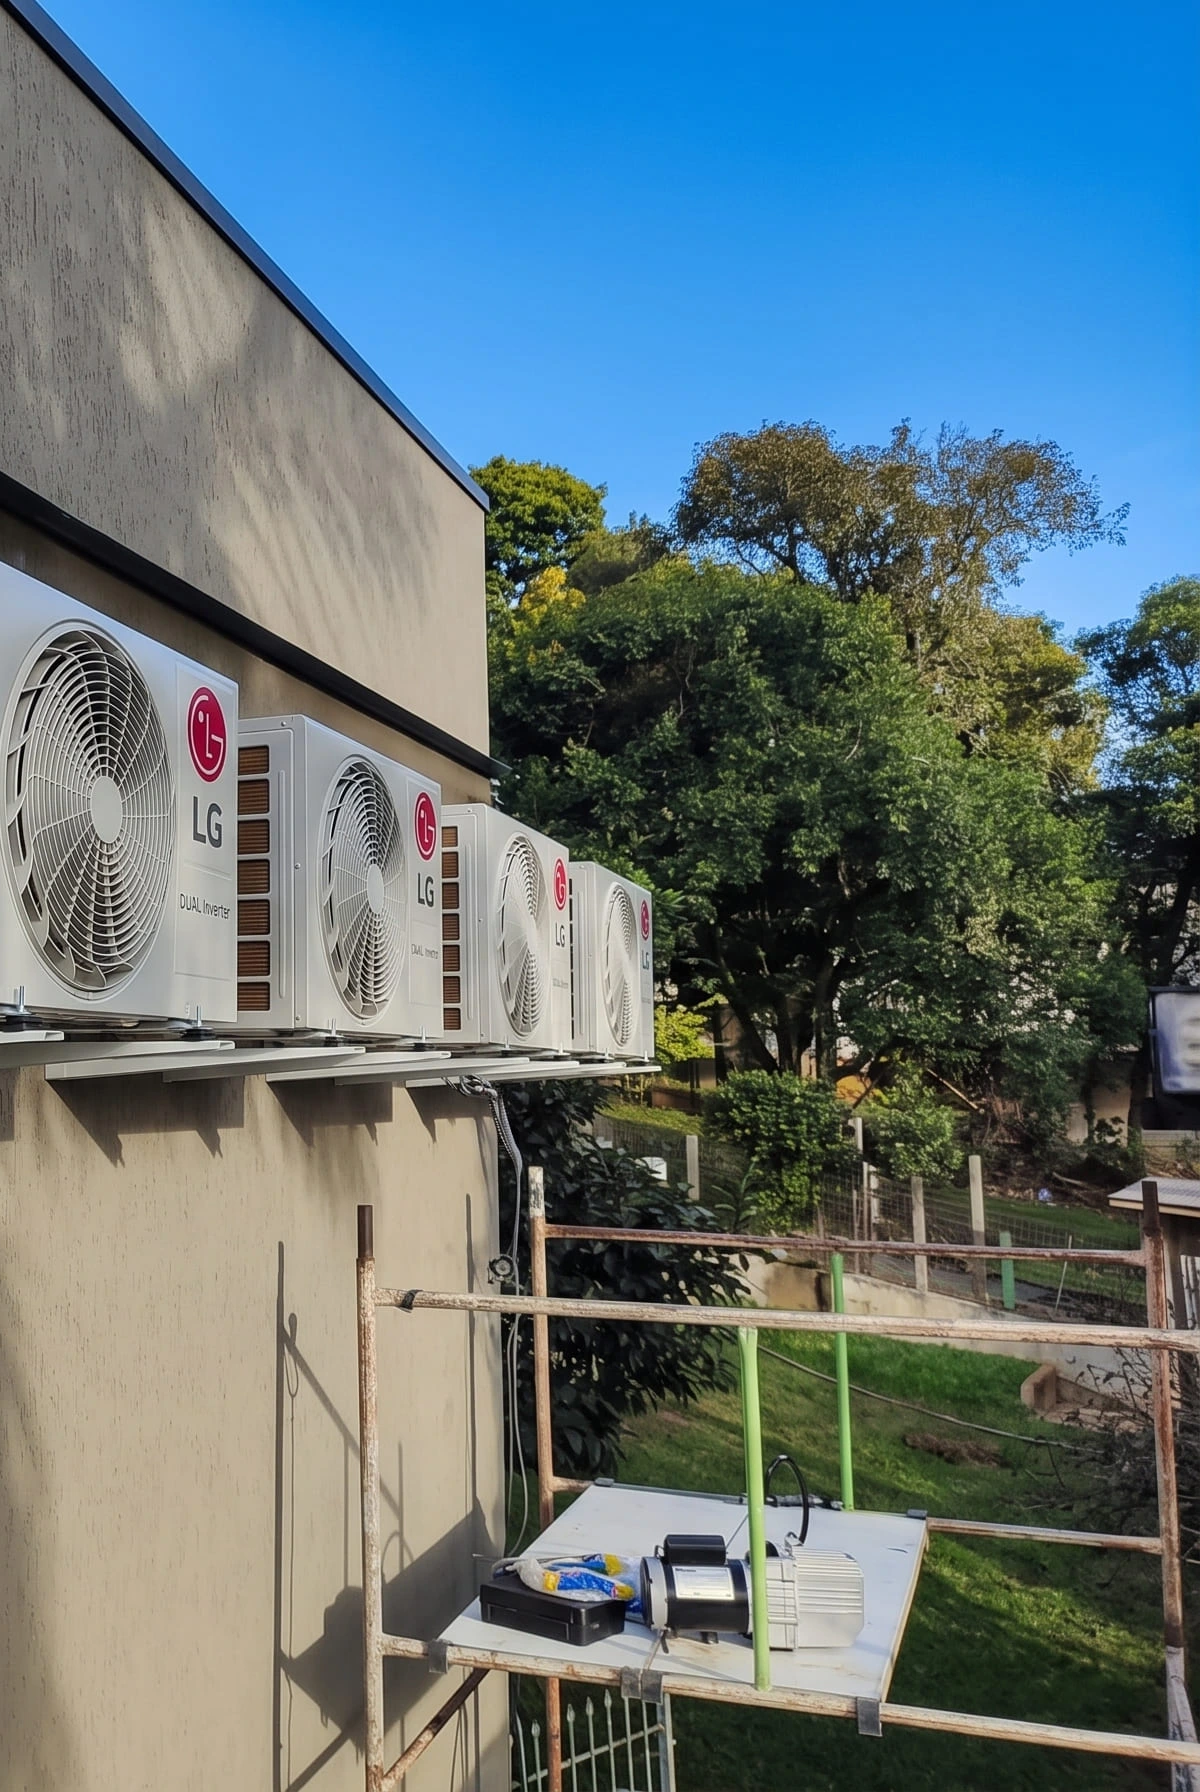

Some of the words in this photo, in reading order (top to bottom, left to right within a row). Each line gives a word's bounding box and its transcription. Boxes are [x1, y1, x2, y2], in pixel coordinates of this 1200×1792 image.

[192, 795, 223, 849] LG
[417, 872, 435, 908] LG
[180, 892, 202, 915] DUAL
[203, 898, 232, 921] Inverter
[555, 921, 566, 948] LG
[641, 949, 650, 970] LG
